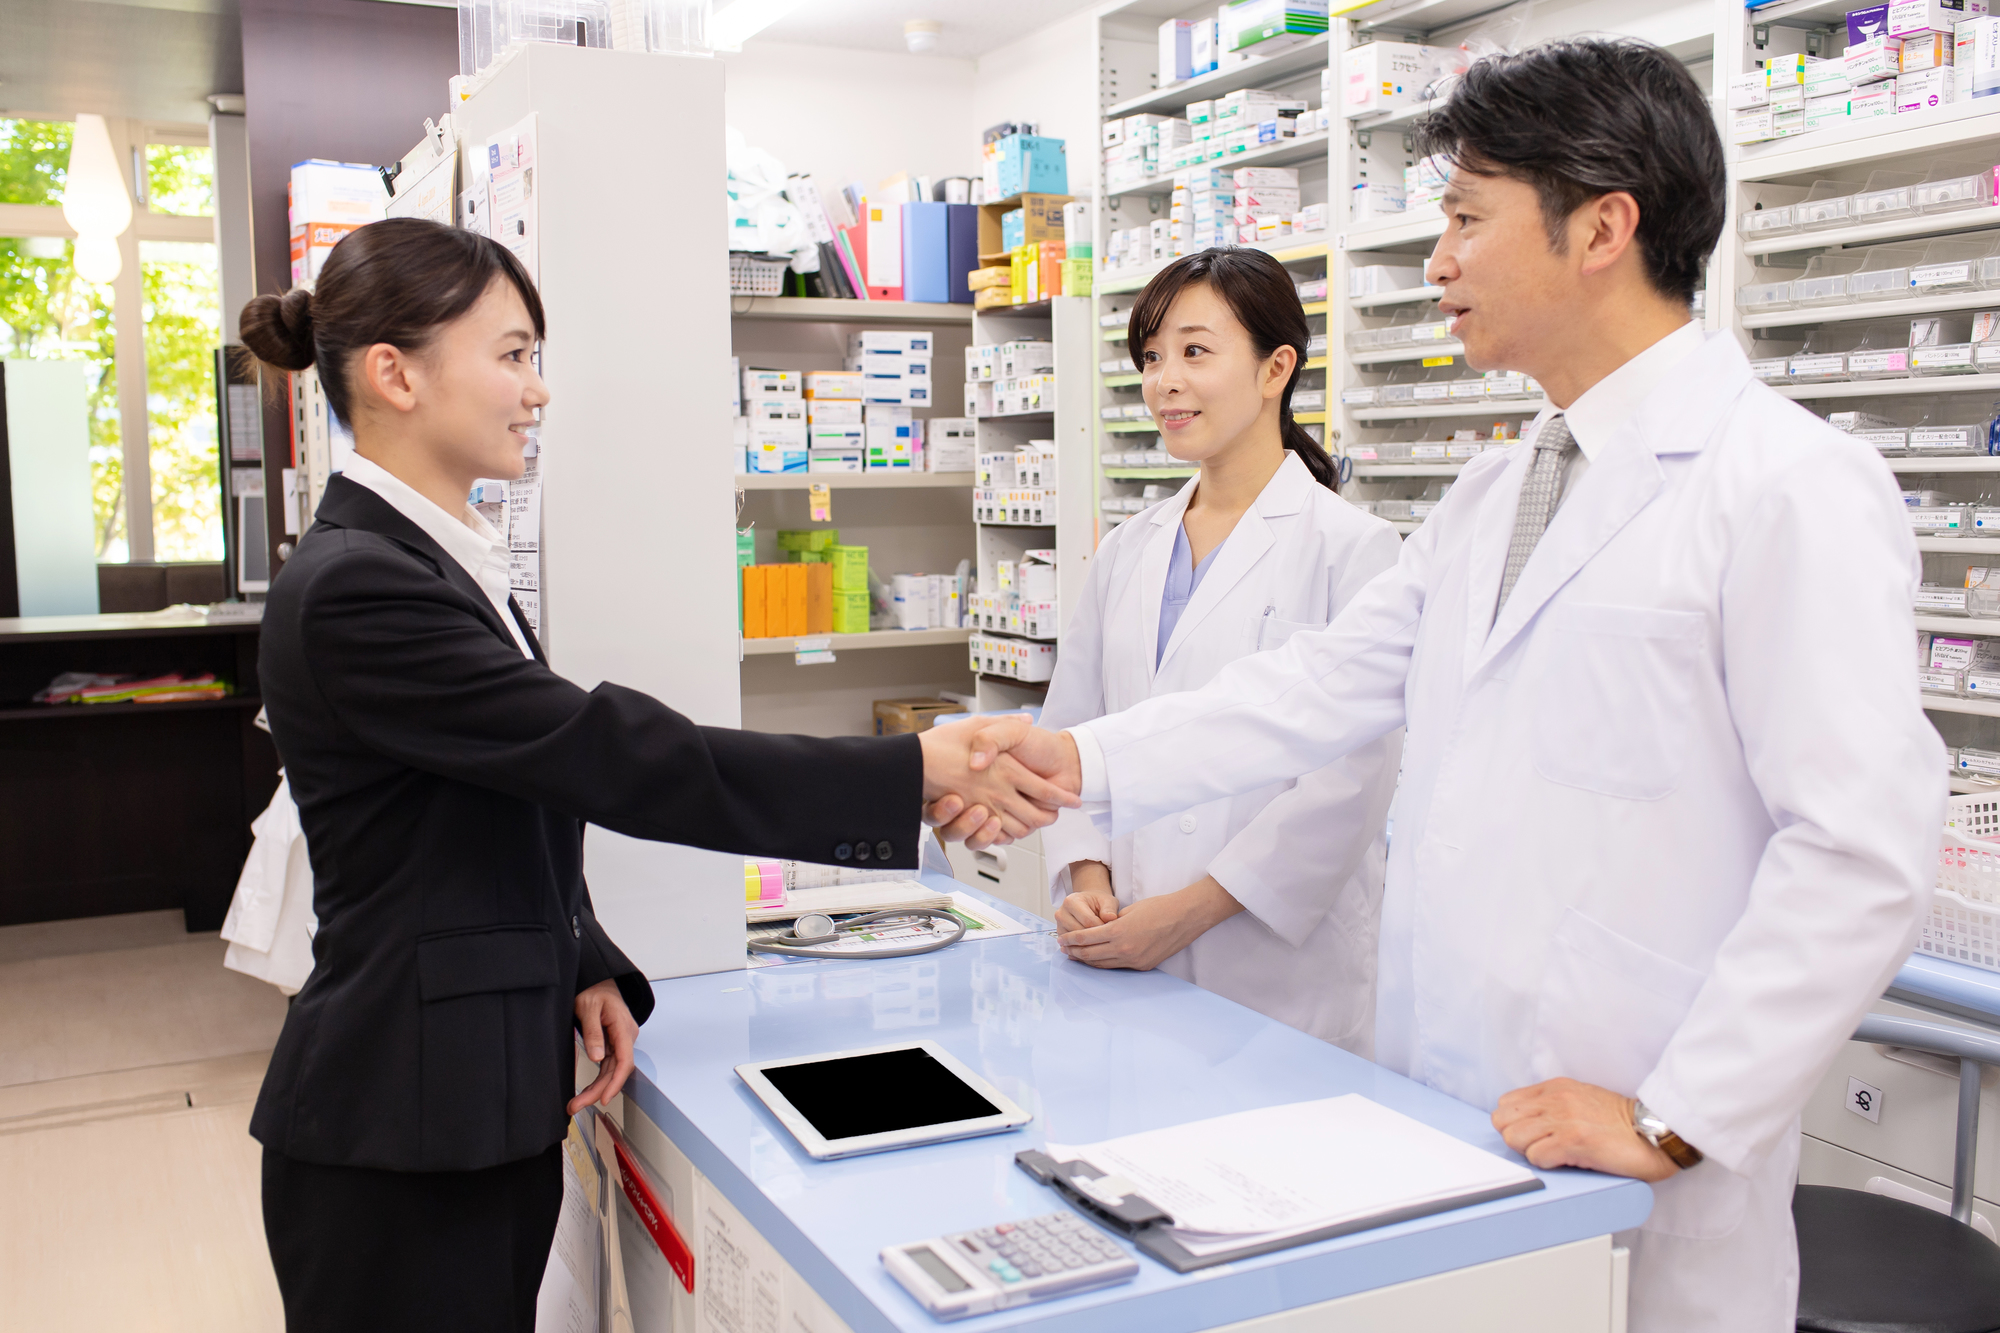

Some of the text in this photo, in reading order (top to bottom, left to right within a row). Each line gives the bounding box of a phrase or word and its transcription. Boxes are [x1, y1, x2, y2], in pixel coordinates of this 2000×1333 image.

[315, 229, 349, 243] メニレッ
[1339, 236, 1344, 249] 2
